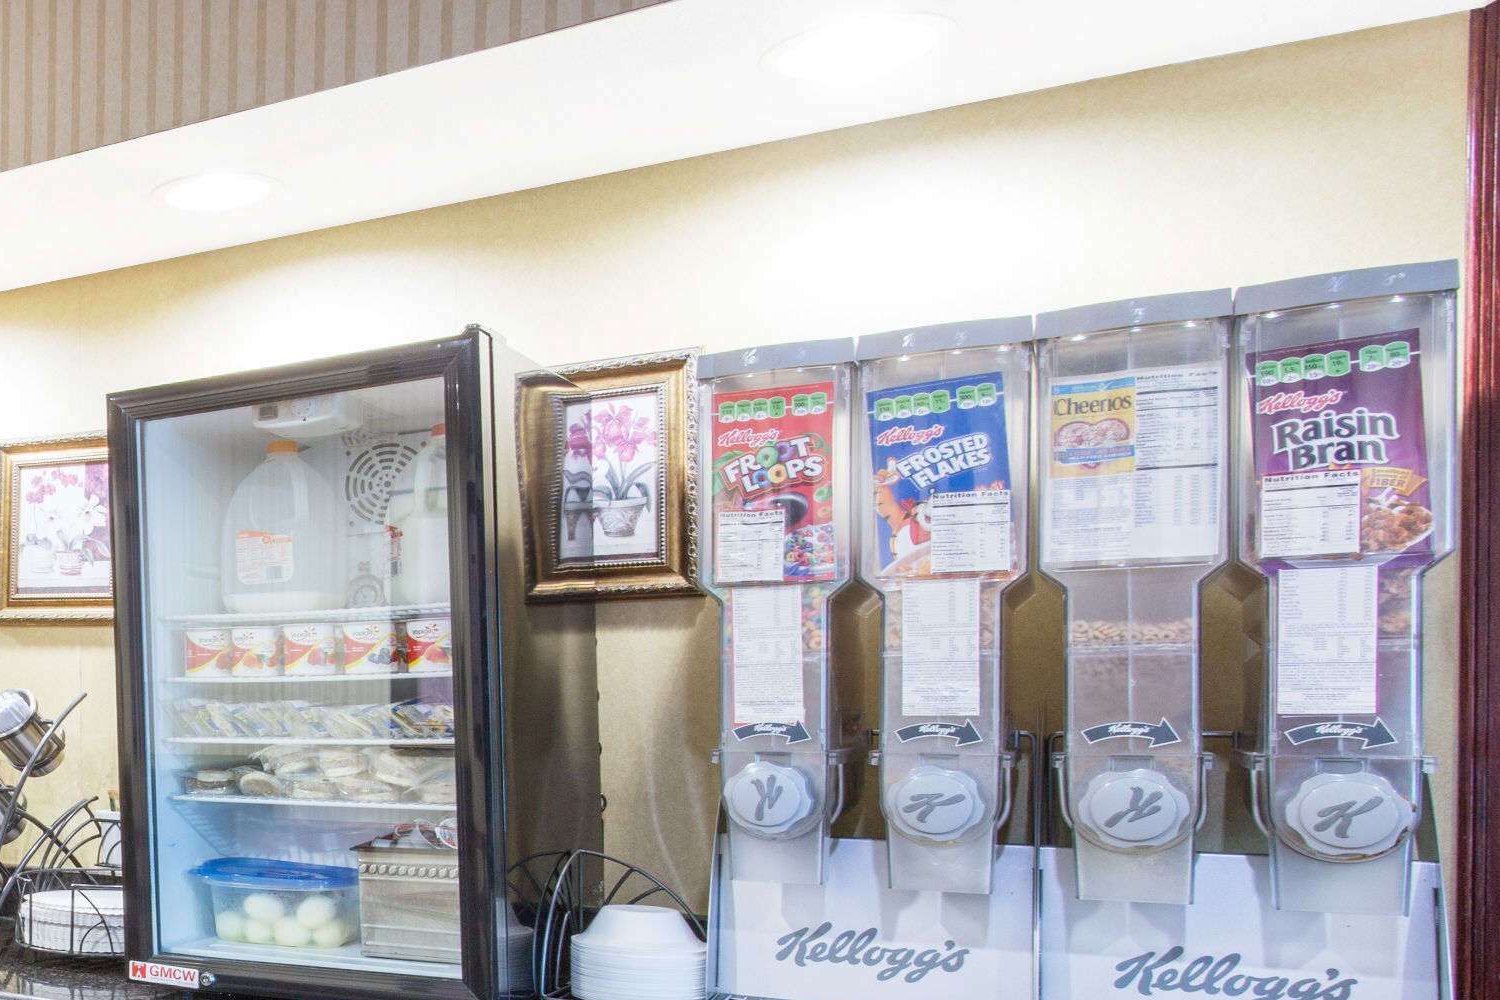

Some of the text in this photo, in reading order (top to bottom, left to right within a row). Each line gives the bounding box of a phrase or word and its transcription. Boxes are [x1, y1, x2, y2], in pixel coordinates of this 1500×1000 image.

[1054, 396, 1132, 416] Cheerios
[1255, 389, 1343, 414] Kellogg's
[717, 428, 780, 447] Kellogg's
[876, 424, 945, 446] Kellogg's
[1271, 407, 1399, 453] Raisin
[724, 437, 810, 483] FROOT
[897, 432, 989, 478] FROSTED
[1288, 439, 1389, 472] Bran
[741, 456, 825, 492] LOOPS
[911, 448, 992, 488] FLAKES
[1264, 474, 1319, 483] Nutrition
[1108, 723, 1150, 735] Kellogg's
[1316, 723, 1363, 736] Kellogg's
[775, 921, 970, 983] Kellogg's
[149, 965, 196, 982] GMCW
